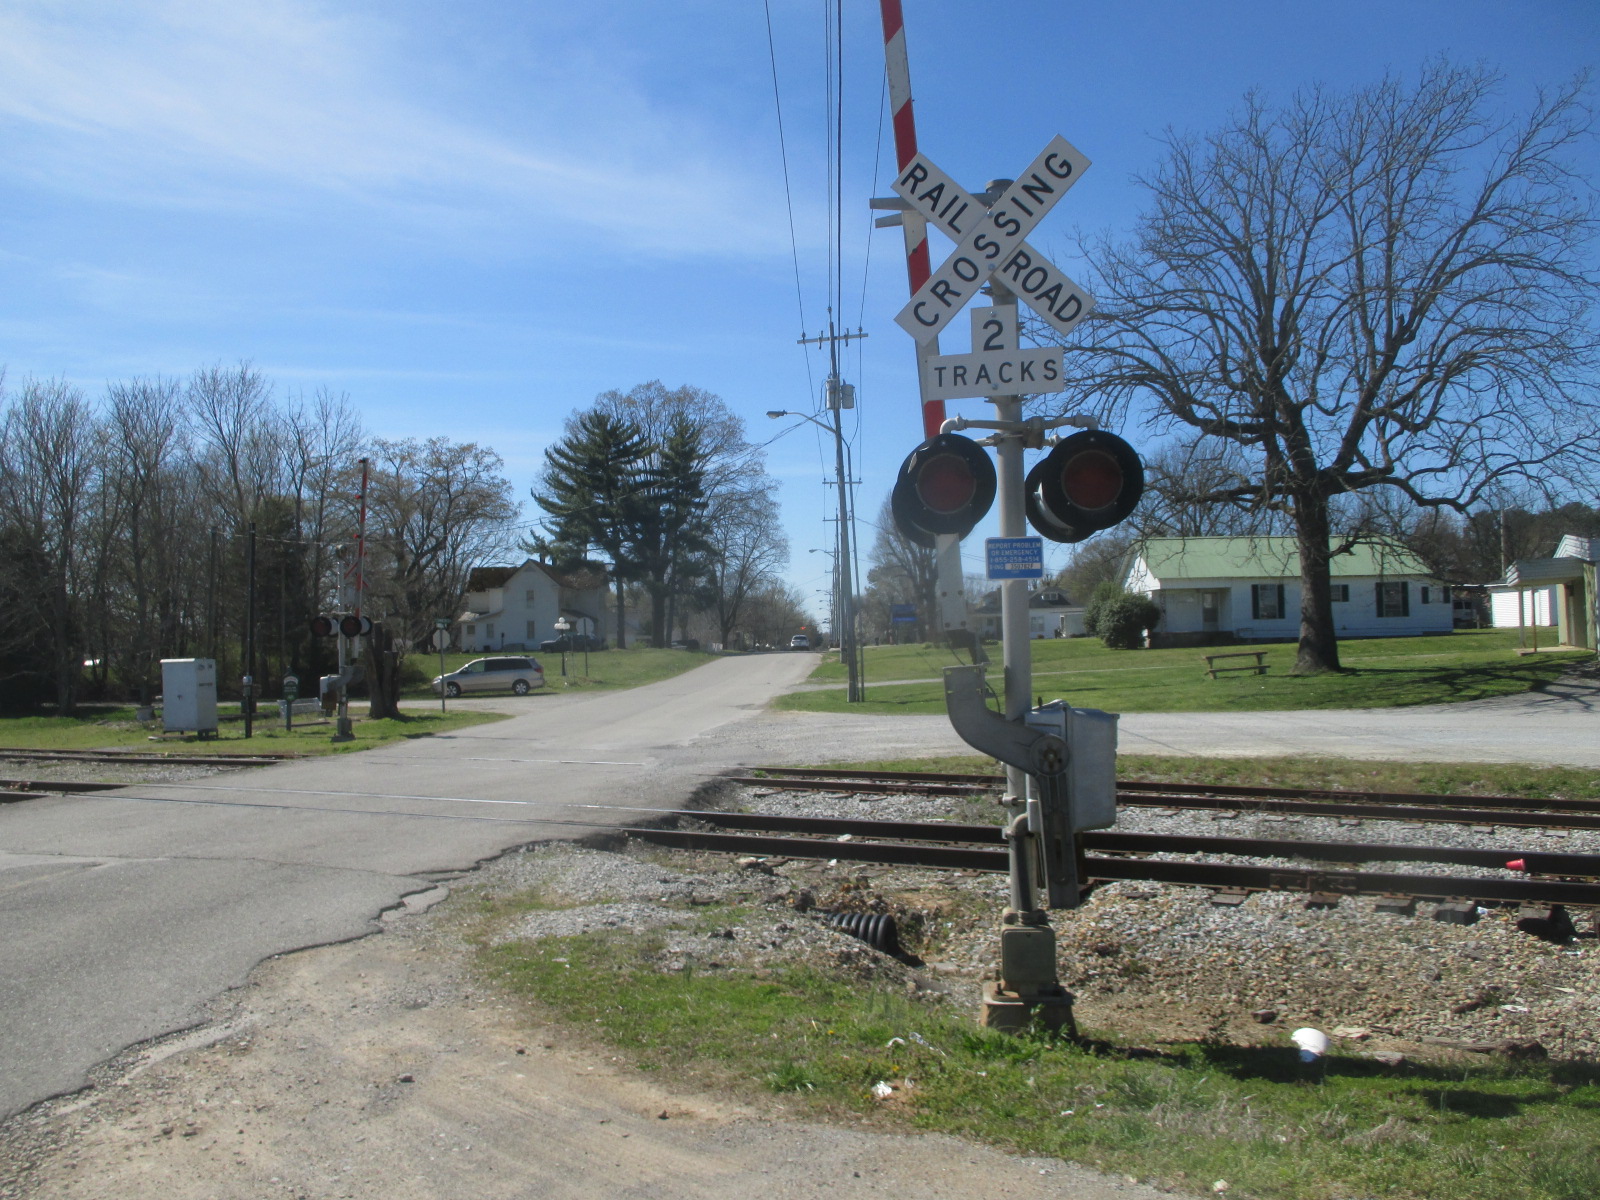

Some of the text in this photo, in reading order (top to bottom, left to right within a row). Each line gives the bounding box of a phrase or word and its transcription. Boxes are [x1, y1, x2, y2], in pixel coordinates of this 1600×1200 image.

[900, 162, 1083, 323] RAIL ROAD
[913, 152, 1073, 327] CROSSING
[934, 358, 1058, 388] TRACKS
[982, 319, 1005, 352] 2
